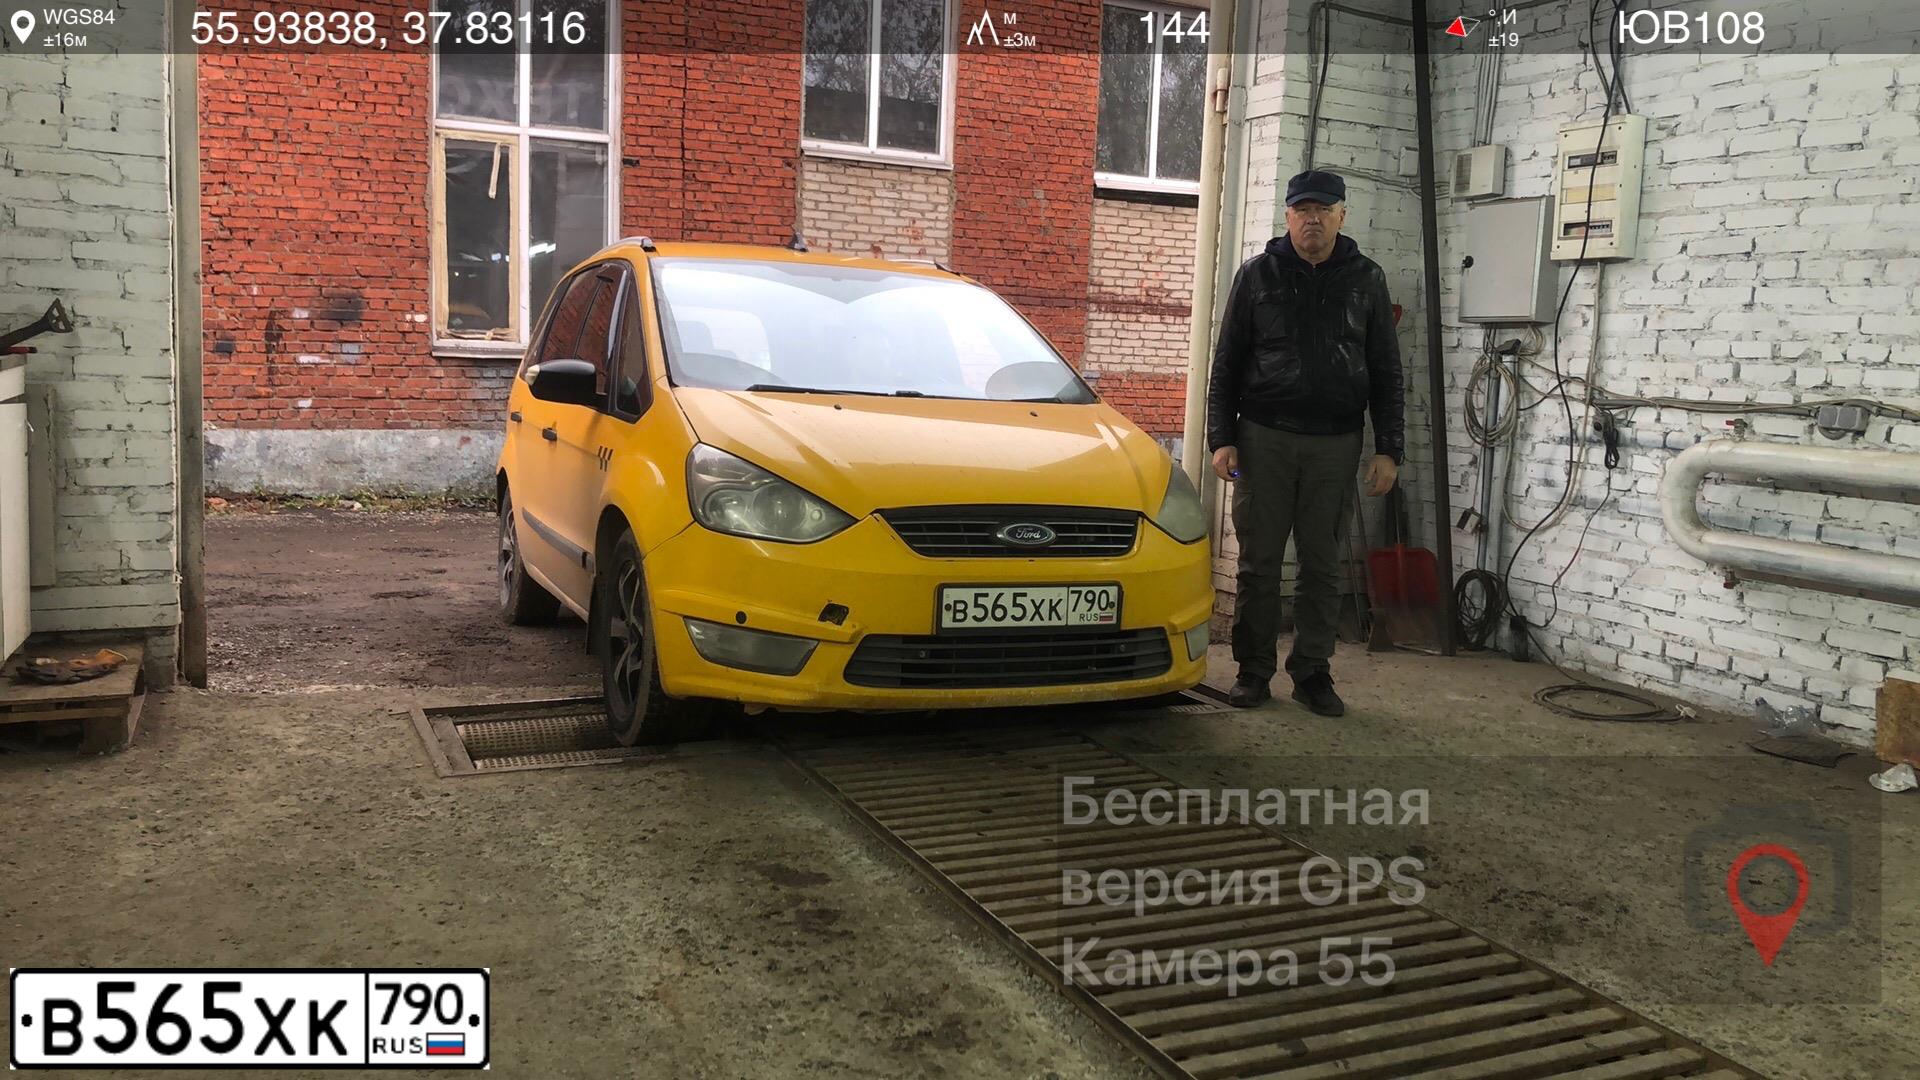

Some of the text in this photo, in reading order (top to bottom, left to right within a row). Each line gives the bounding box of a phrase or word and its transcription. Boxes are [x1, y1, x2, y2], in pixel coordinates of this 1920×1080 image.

[1015, 526, 1041, 540] Ford
[1070, 589, 1110, 613] 790
[1079, 612, 1099, 623] RUS
